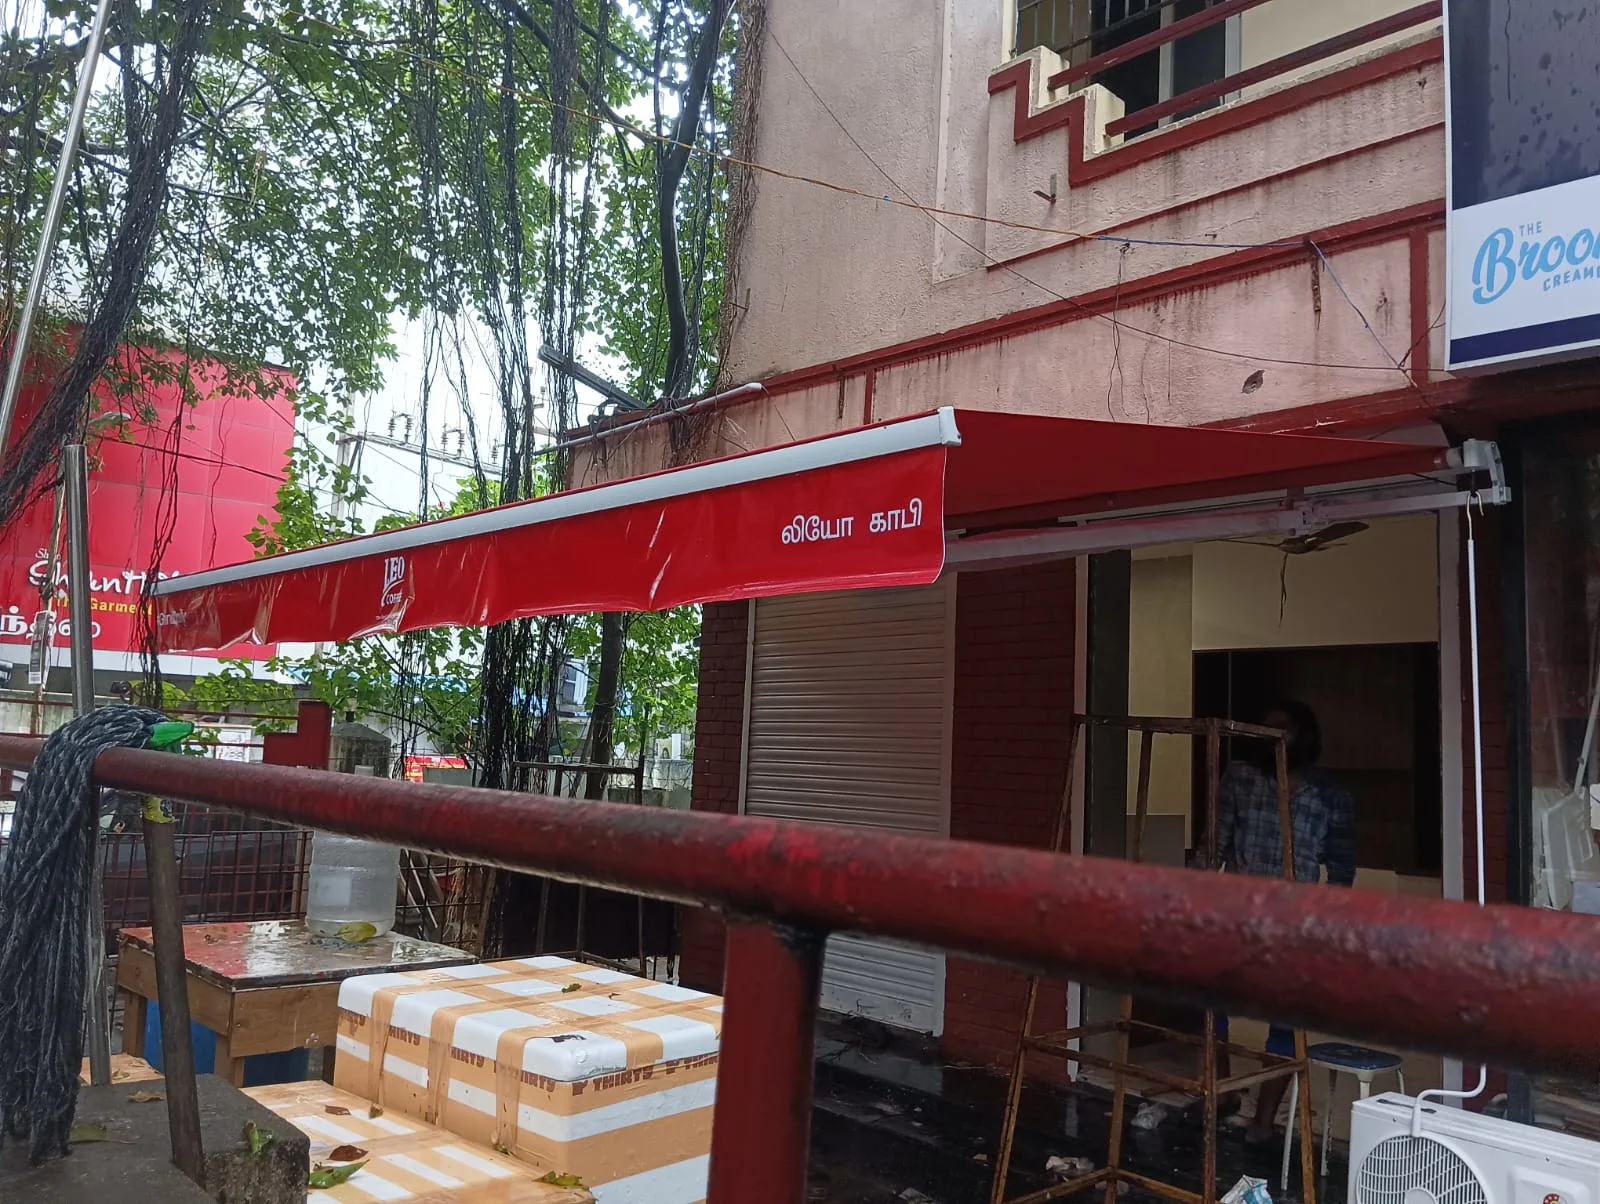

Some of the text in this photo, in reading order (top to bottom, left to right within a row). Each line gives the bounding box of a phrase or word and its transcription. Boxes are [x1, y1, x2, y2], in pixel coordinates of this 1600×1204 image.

[1518, 220, 1543, 237] THE
[1472, 227, 1600, 304] Broo
[781, 497, 923, 544] லியோ காபி
